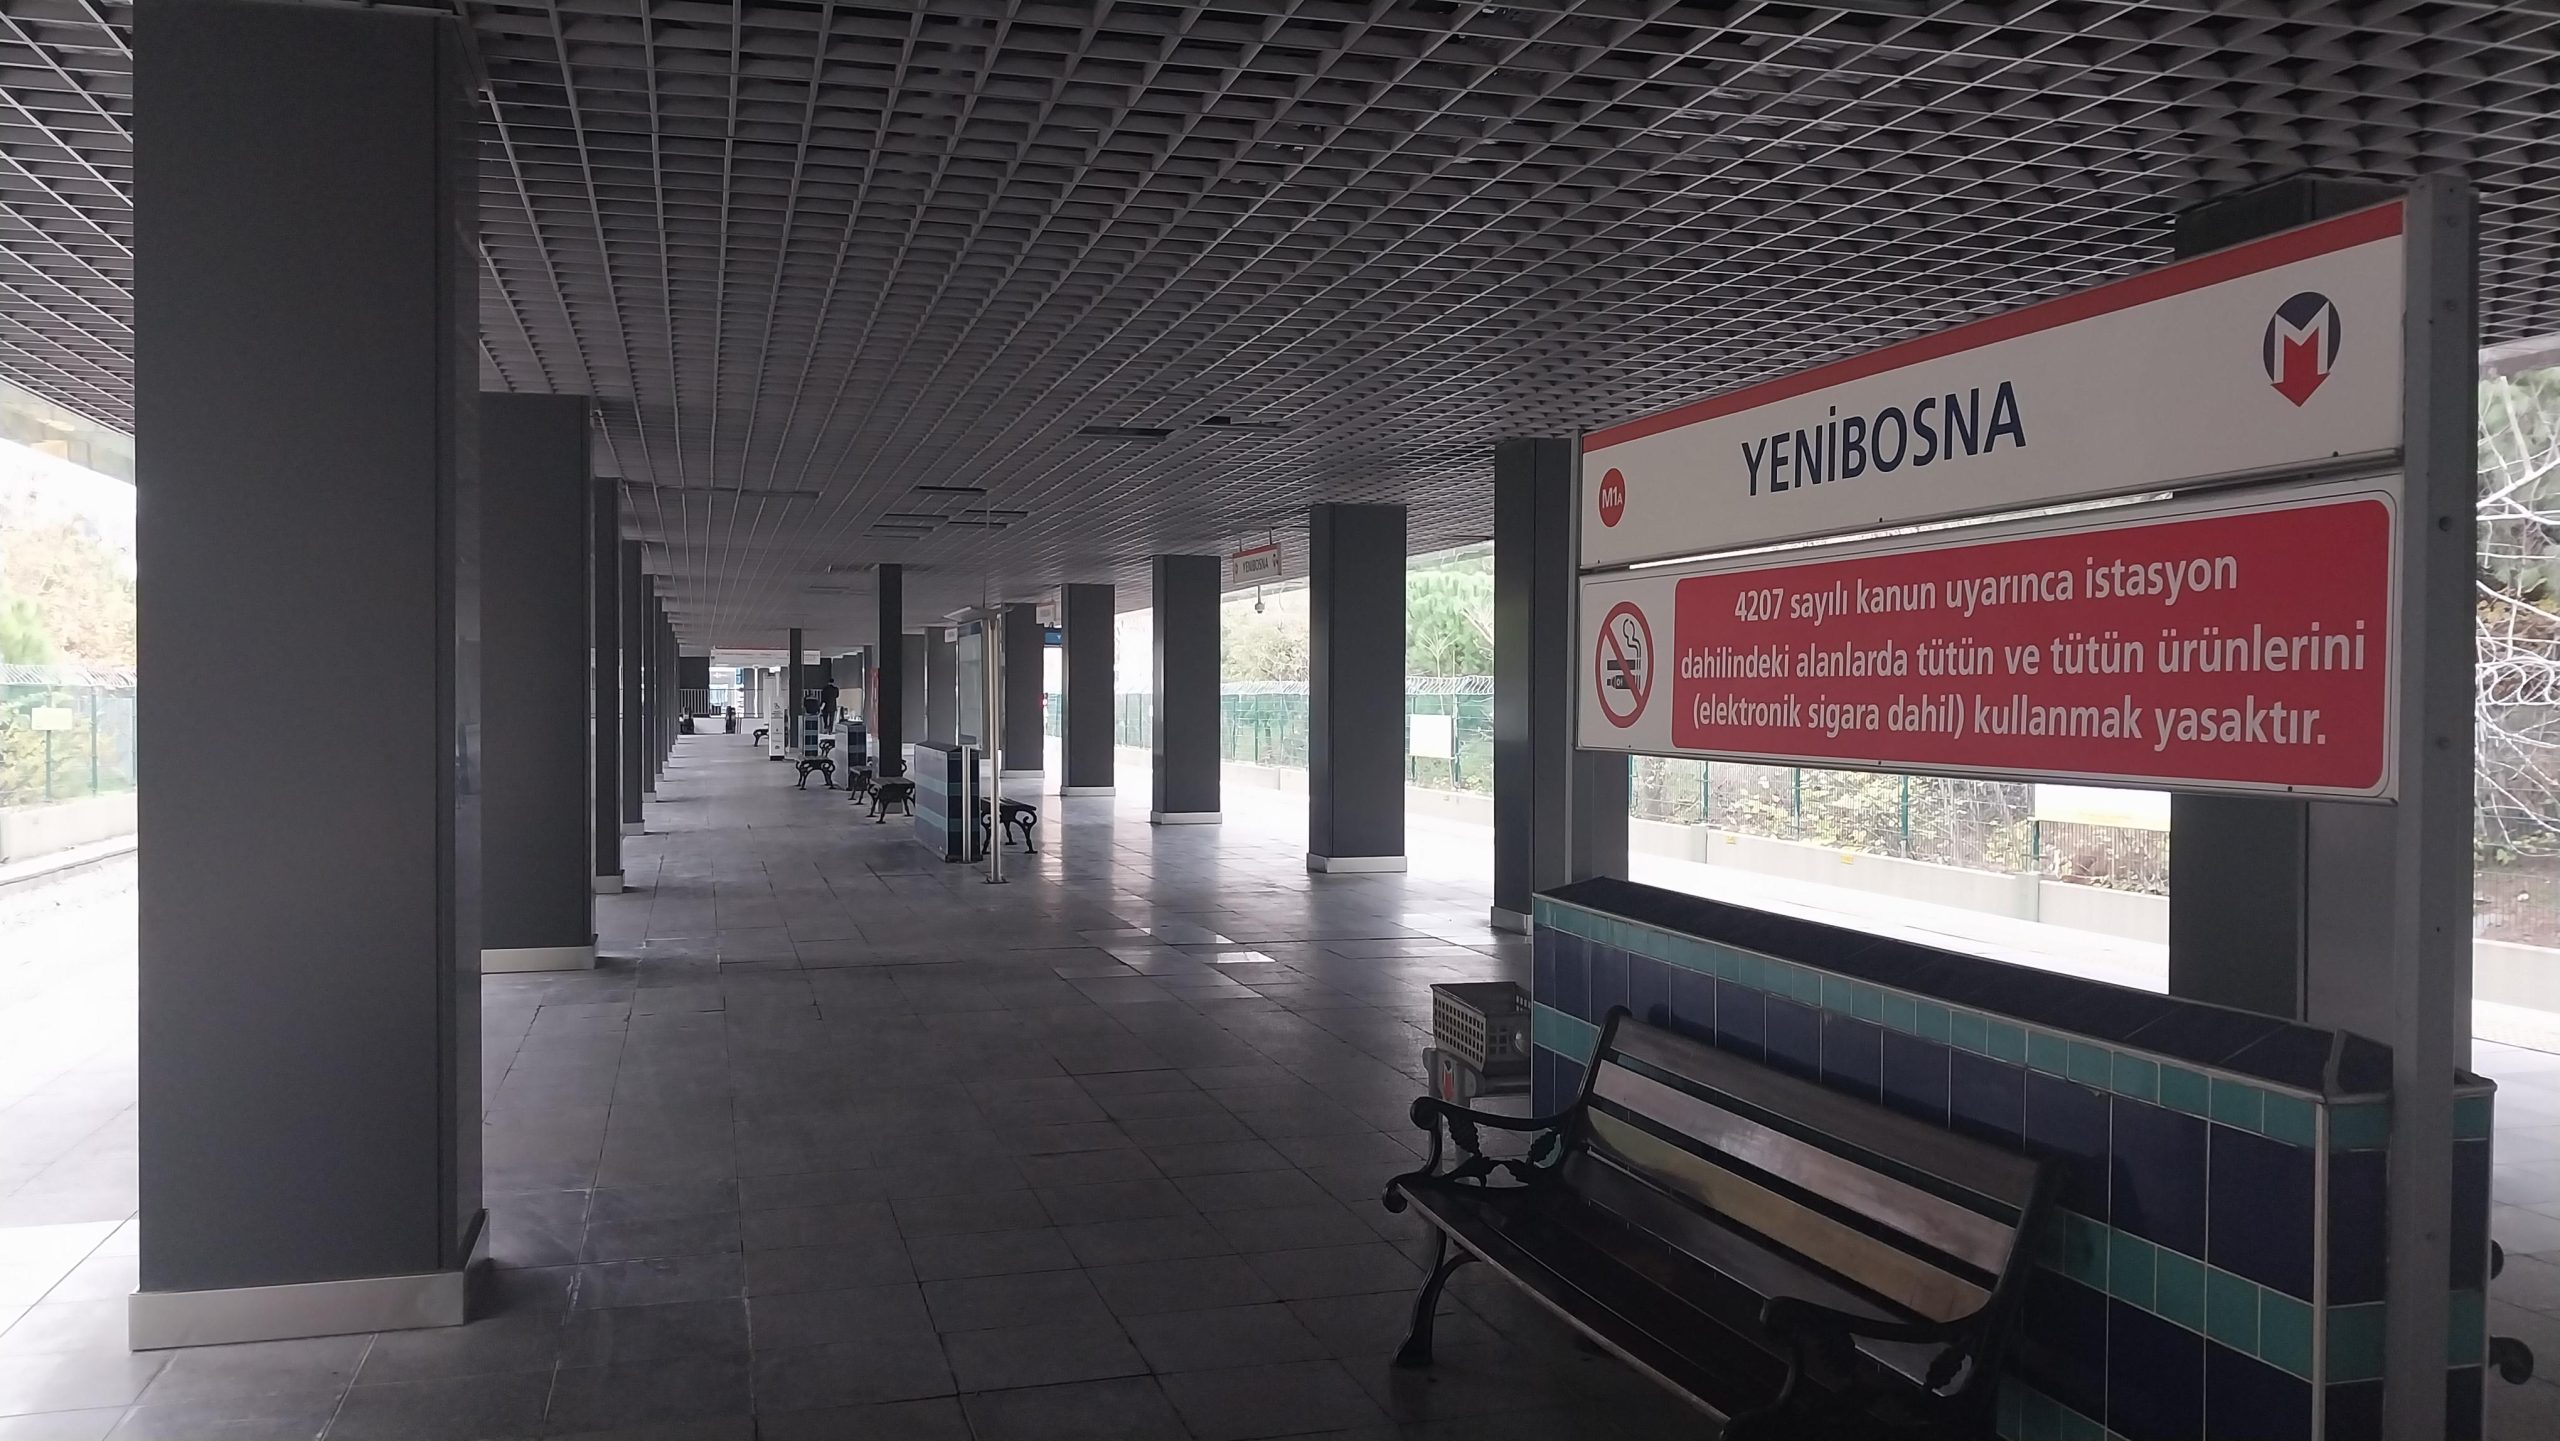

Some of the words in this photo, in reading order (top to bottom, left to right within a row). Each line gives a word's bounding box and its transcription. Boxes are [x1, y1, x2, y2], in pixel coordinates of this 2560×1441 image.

[1741, 380, 2027, 496] YENİBOSNA
[1734, 588, 1784, 622] 4207
[1790, 580, 1848, 627] sayılı
[1856, 578, 1936, 614] kanun
[1946, 568, 2074, 617] uyarınca
[2085, 555, 2238, 606] istasyon
[1681, 644, 1790, 679] dahilindeki
[1795, 639, 1908, 677] alanlarda
[1916, 637, 1994, 676] tütün
[2004, 644, 2040, 675] ve
[2050, 631, 2144, 674] tütün
[2157, 619, 2365, 673] ürünlerini
[1693, 692, 1802, 729] (elektronik
[1808, 694, 1880, 738] sigara
[1887, 693, 1966, 740] dahil)
[1973, 694, 2144, 740] kullanmak
[2153, 694, 2326, 752] yasaktır.
